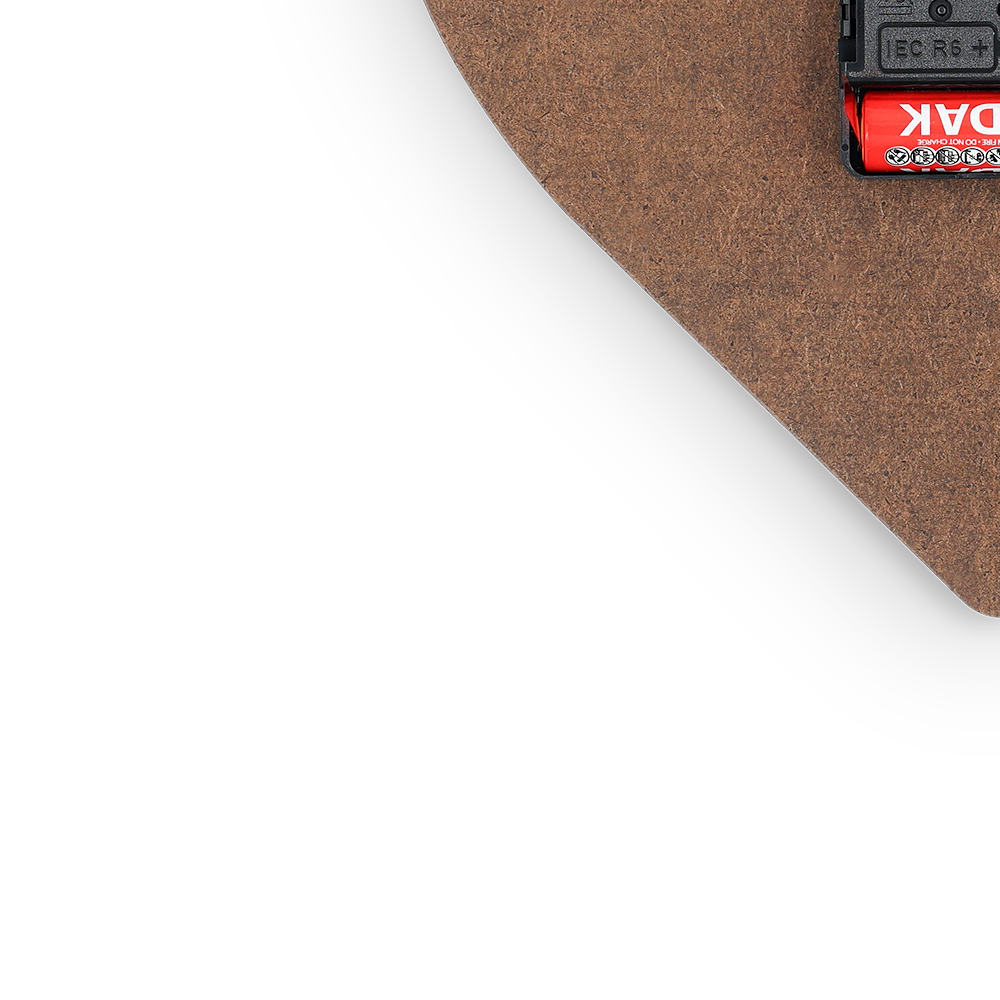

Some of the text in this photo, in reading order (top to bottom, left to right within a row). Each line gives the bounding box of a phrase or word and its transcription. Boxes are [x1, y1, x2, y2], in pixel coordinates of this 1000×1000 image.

[887, 40, 922, 57] IEC
[933, 40, 962, 57] R6
[917, 138, 948, 146] CHARGE
[949, 138, 964, 146] NOT
[964, 138, 977, 146] DO
[982, 138, 996, 146] FIRE
